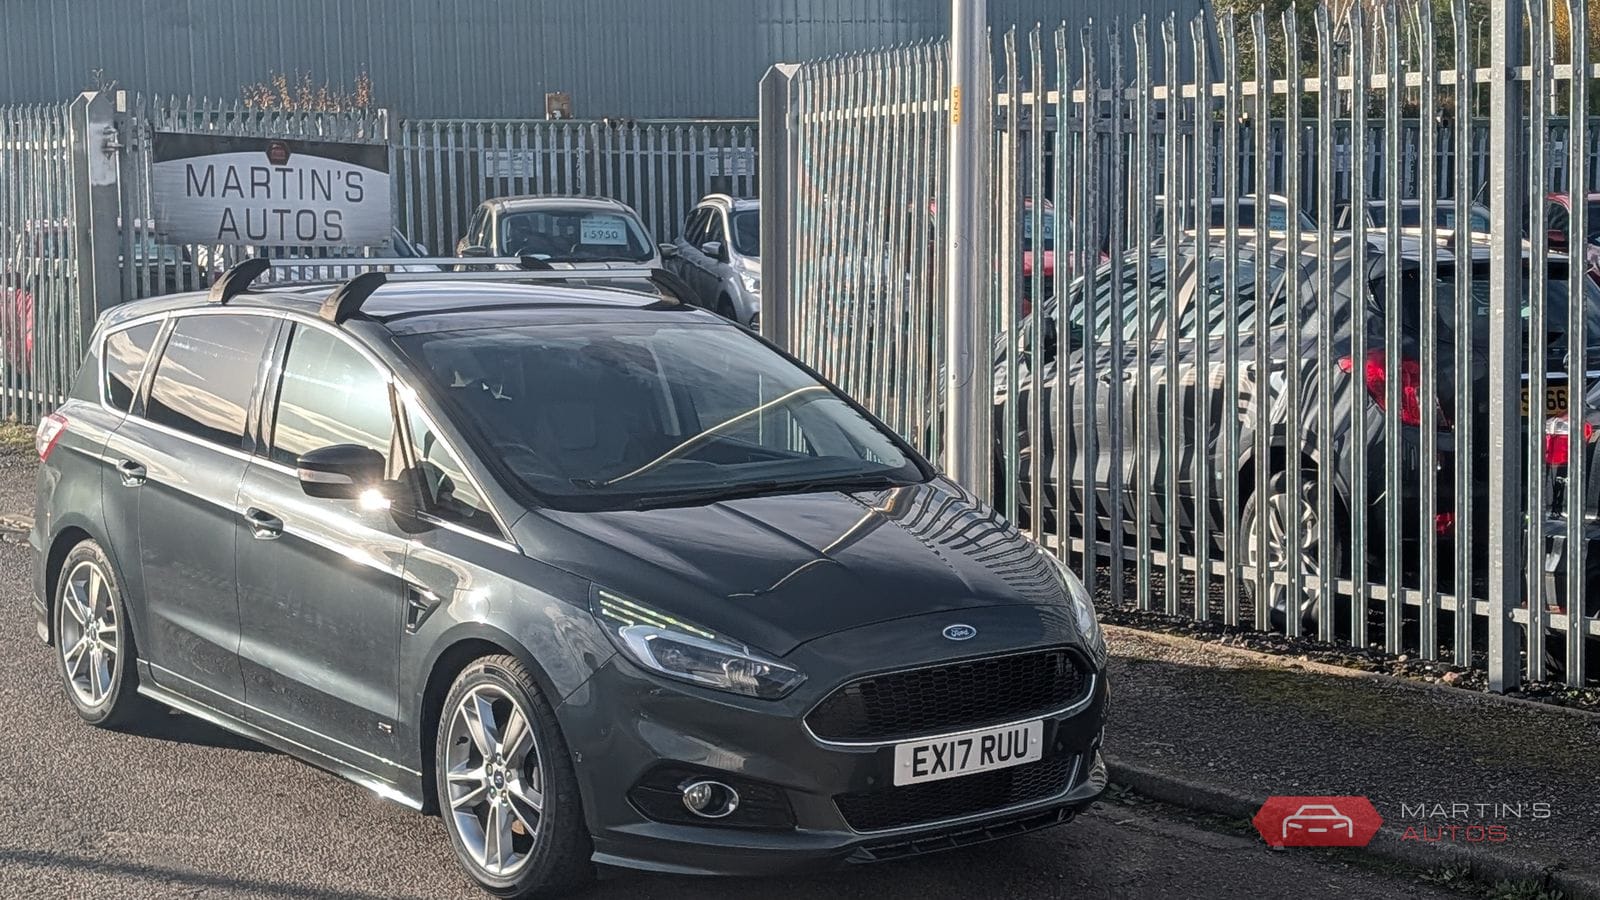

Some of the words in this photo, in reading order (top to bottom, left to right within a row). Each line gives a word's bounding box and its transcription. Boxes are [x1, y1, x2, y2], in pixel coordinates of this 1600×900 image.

[186, 163, 364, 203] MARTIN'S
[217, 207, 344, 242] AUTOS
[1520, 389, 1568, 412] S66
[912, 738, 973, 778] EX17
[980, 728, 1029, 766] RUU
